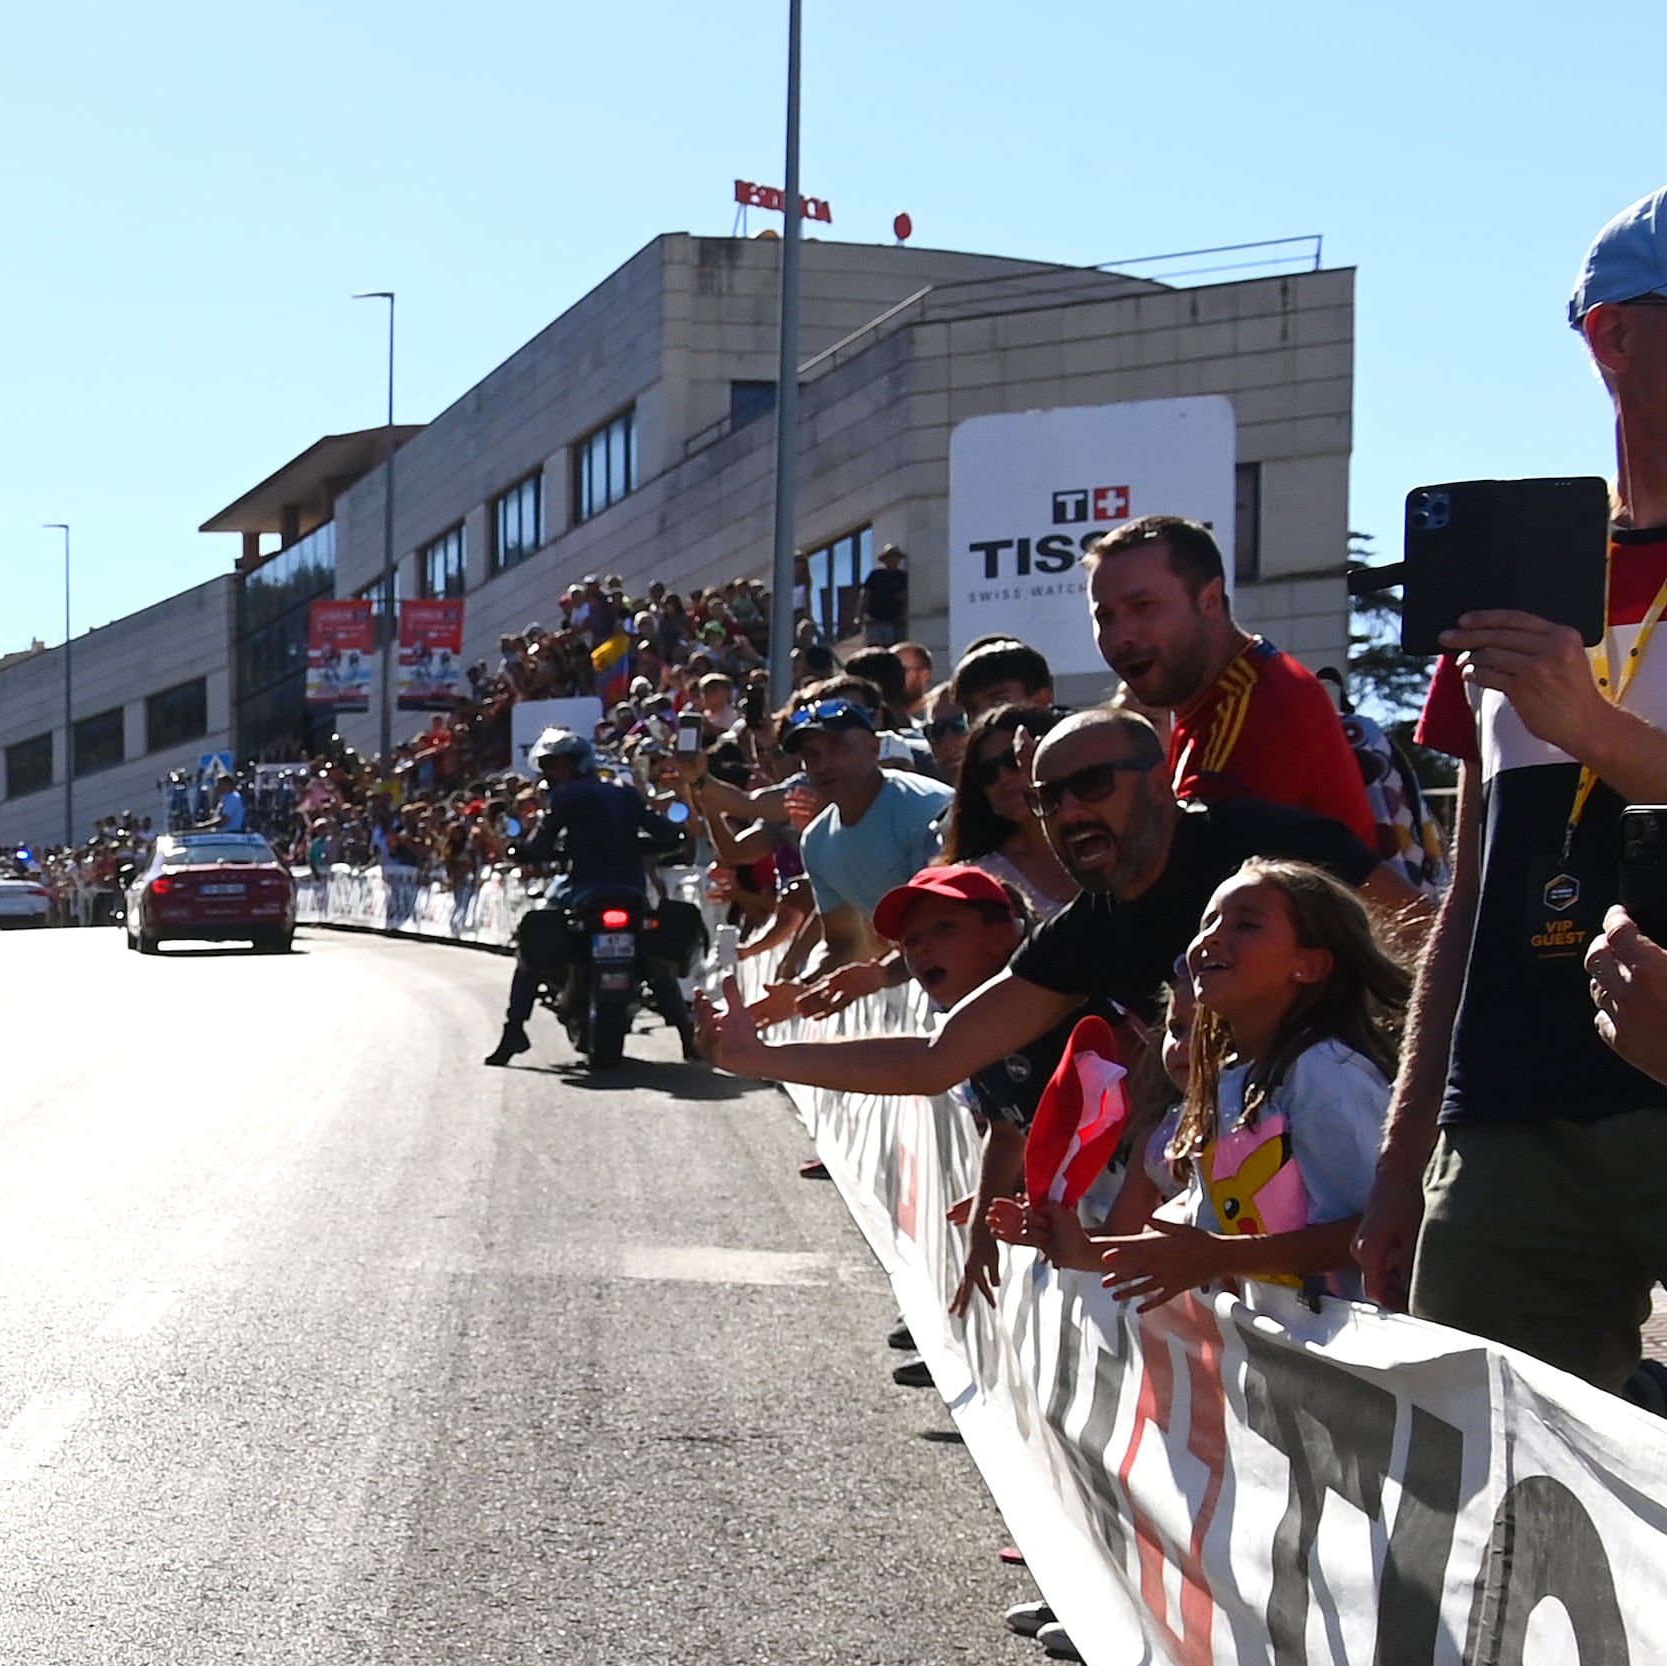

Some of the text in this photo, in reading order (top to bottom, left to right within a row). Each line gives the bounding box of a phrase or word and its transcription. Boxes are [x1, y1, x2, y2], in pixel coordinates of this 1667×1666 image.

[969, 580, 1089, 604] SWISS WATCH
[1547, 920, 1574, 933] VIP
[1531, 931, 1587, 947] GUEST
